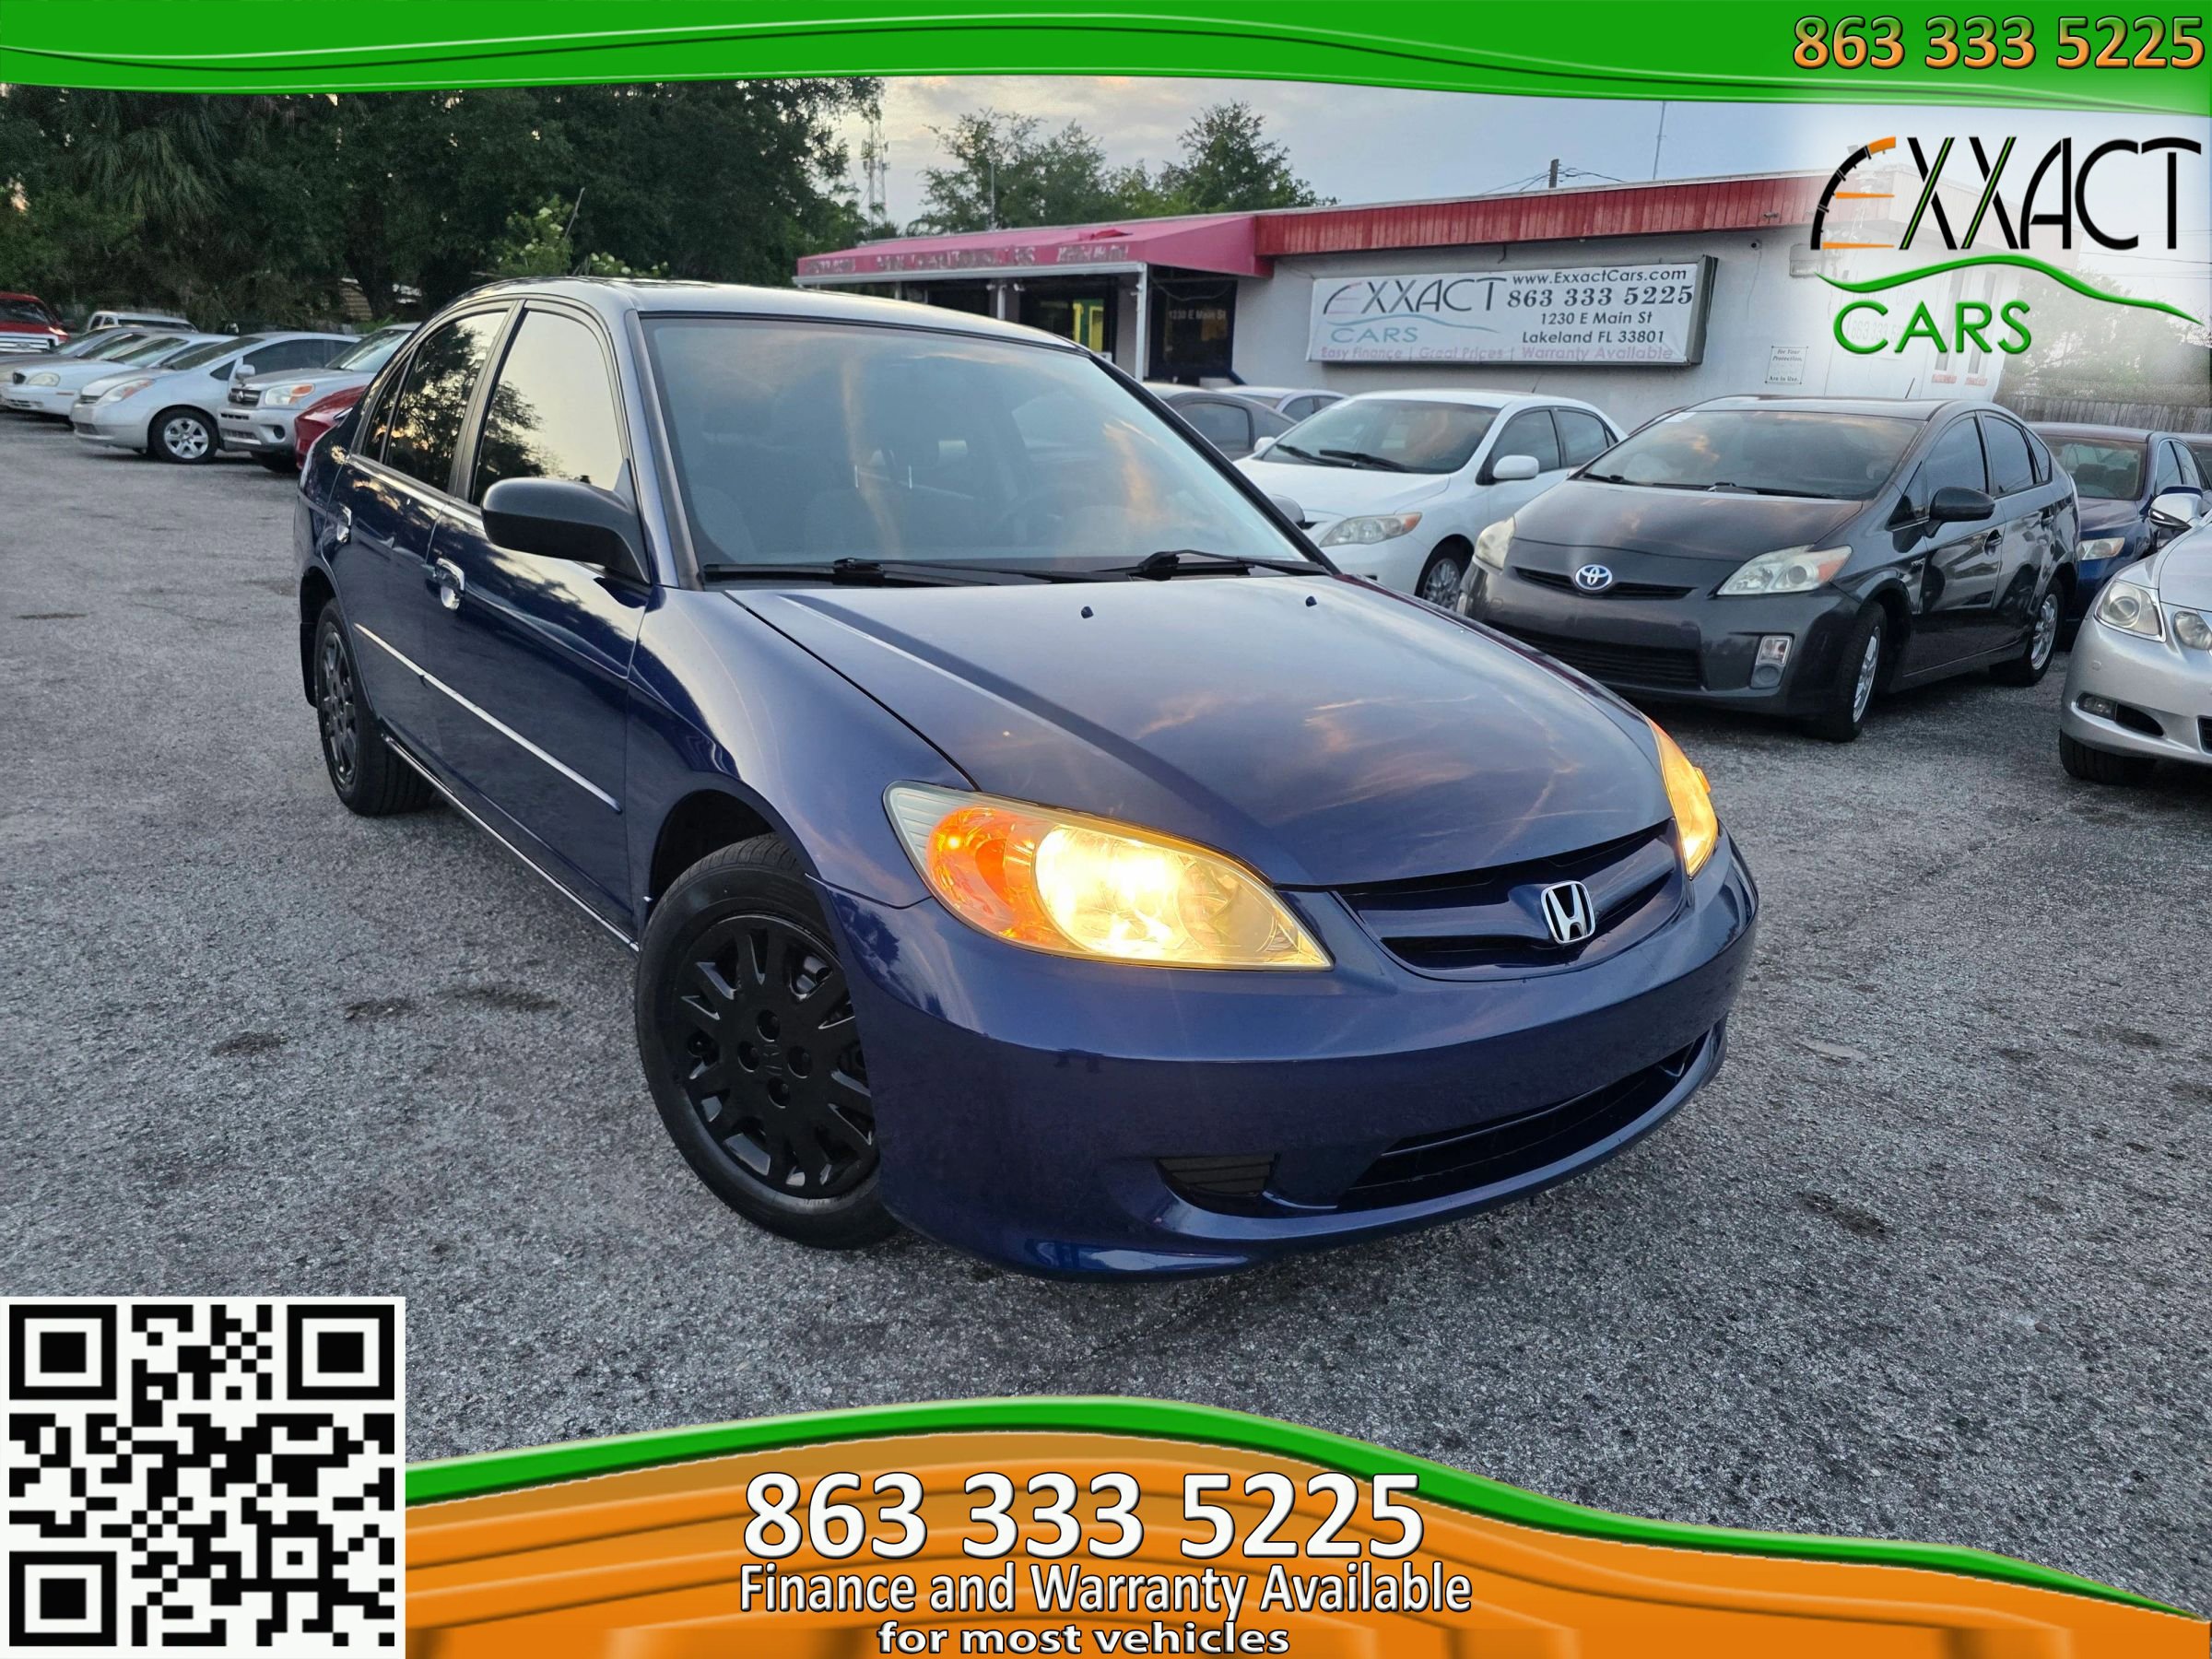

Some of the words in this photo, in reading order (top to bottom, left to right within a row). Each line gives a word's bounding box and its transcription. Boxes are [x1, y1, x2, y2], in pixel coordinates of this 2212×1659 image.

[1512, 270, 1687, 285] www.ExxactCars.com
[1324, 276, 1507, 314] EXXACT
[1507, 289, 1553, 308] 863
[1564, 288, 1612, 306] 333
[1624, 285, 1693, 305] 5225
[1541, 313, 1574, 324] 1230
[1580, 312, 1588, 324] E
[1593, 312, 1631, 324] Main
[1638, 312, 1653, 324] St
[1331, 327, 1418, 343] CARS
[1523, 331, 1593, 344] Lakeland
[1598, 332, 1612, 343] FL
[1618, 330, 1664, 343] 33801
[1322, 347, 1347, 360] Easy
[1352, 347, 1402, 360] Finance
[1418, 347, 1461, 359] Great
[1463, 347, 1503, 360] Prices
[1523, 347, 1589, 361] Warranty
[1594, 347, 1673, 359] Available
